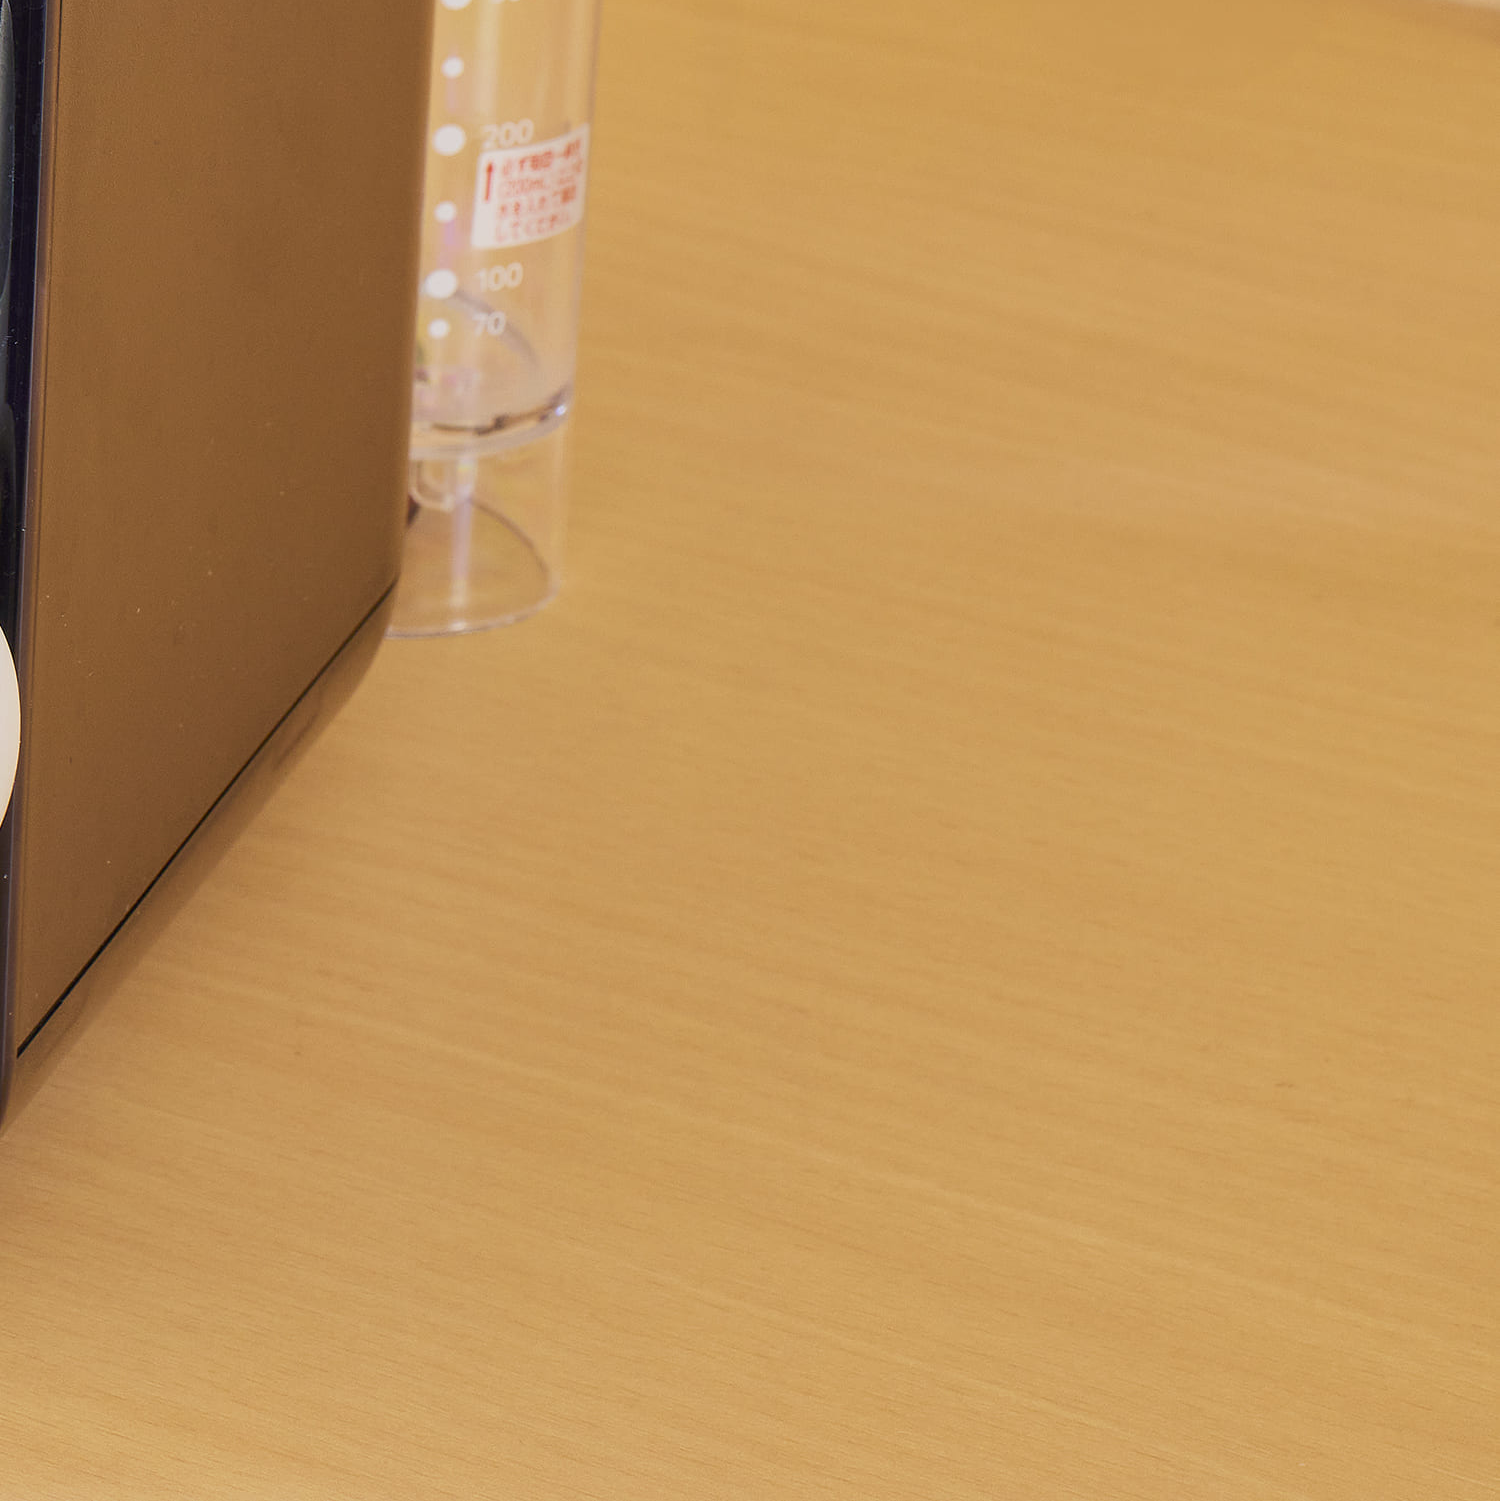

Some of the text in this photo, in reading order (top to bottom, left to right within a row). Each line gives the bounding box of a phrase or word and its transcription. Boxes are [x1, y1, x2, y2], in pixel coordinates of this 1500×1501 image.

[482, 117, 535, 151] 200
[475, 261, 524, 292] 100
[472, 311, 506, 337] 70
